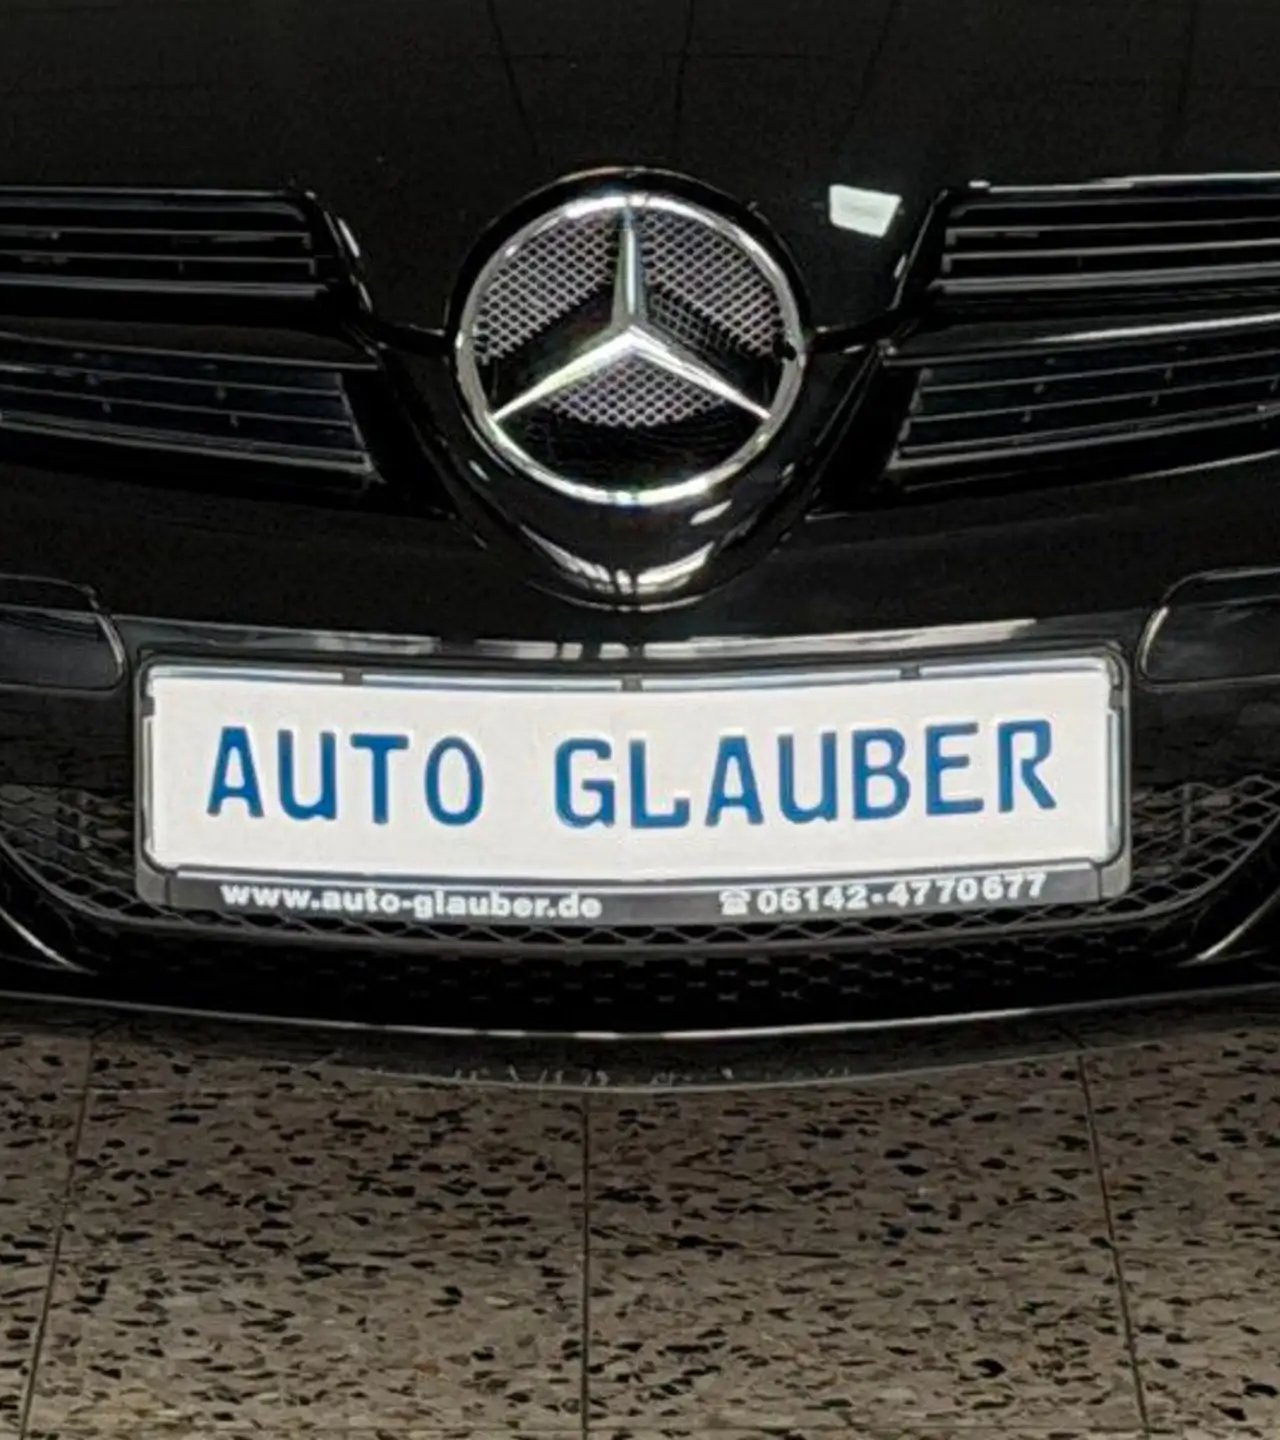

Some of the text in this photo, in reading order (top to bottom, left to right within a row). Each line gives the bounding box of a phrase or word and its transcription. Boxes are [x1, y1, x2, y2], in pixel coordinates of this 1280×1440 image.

[206, 719, 1057, 829] AUTO GLAUBER
[220, 862, 1047, 919] www.auto-glauber.de 06142-4770677
